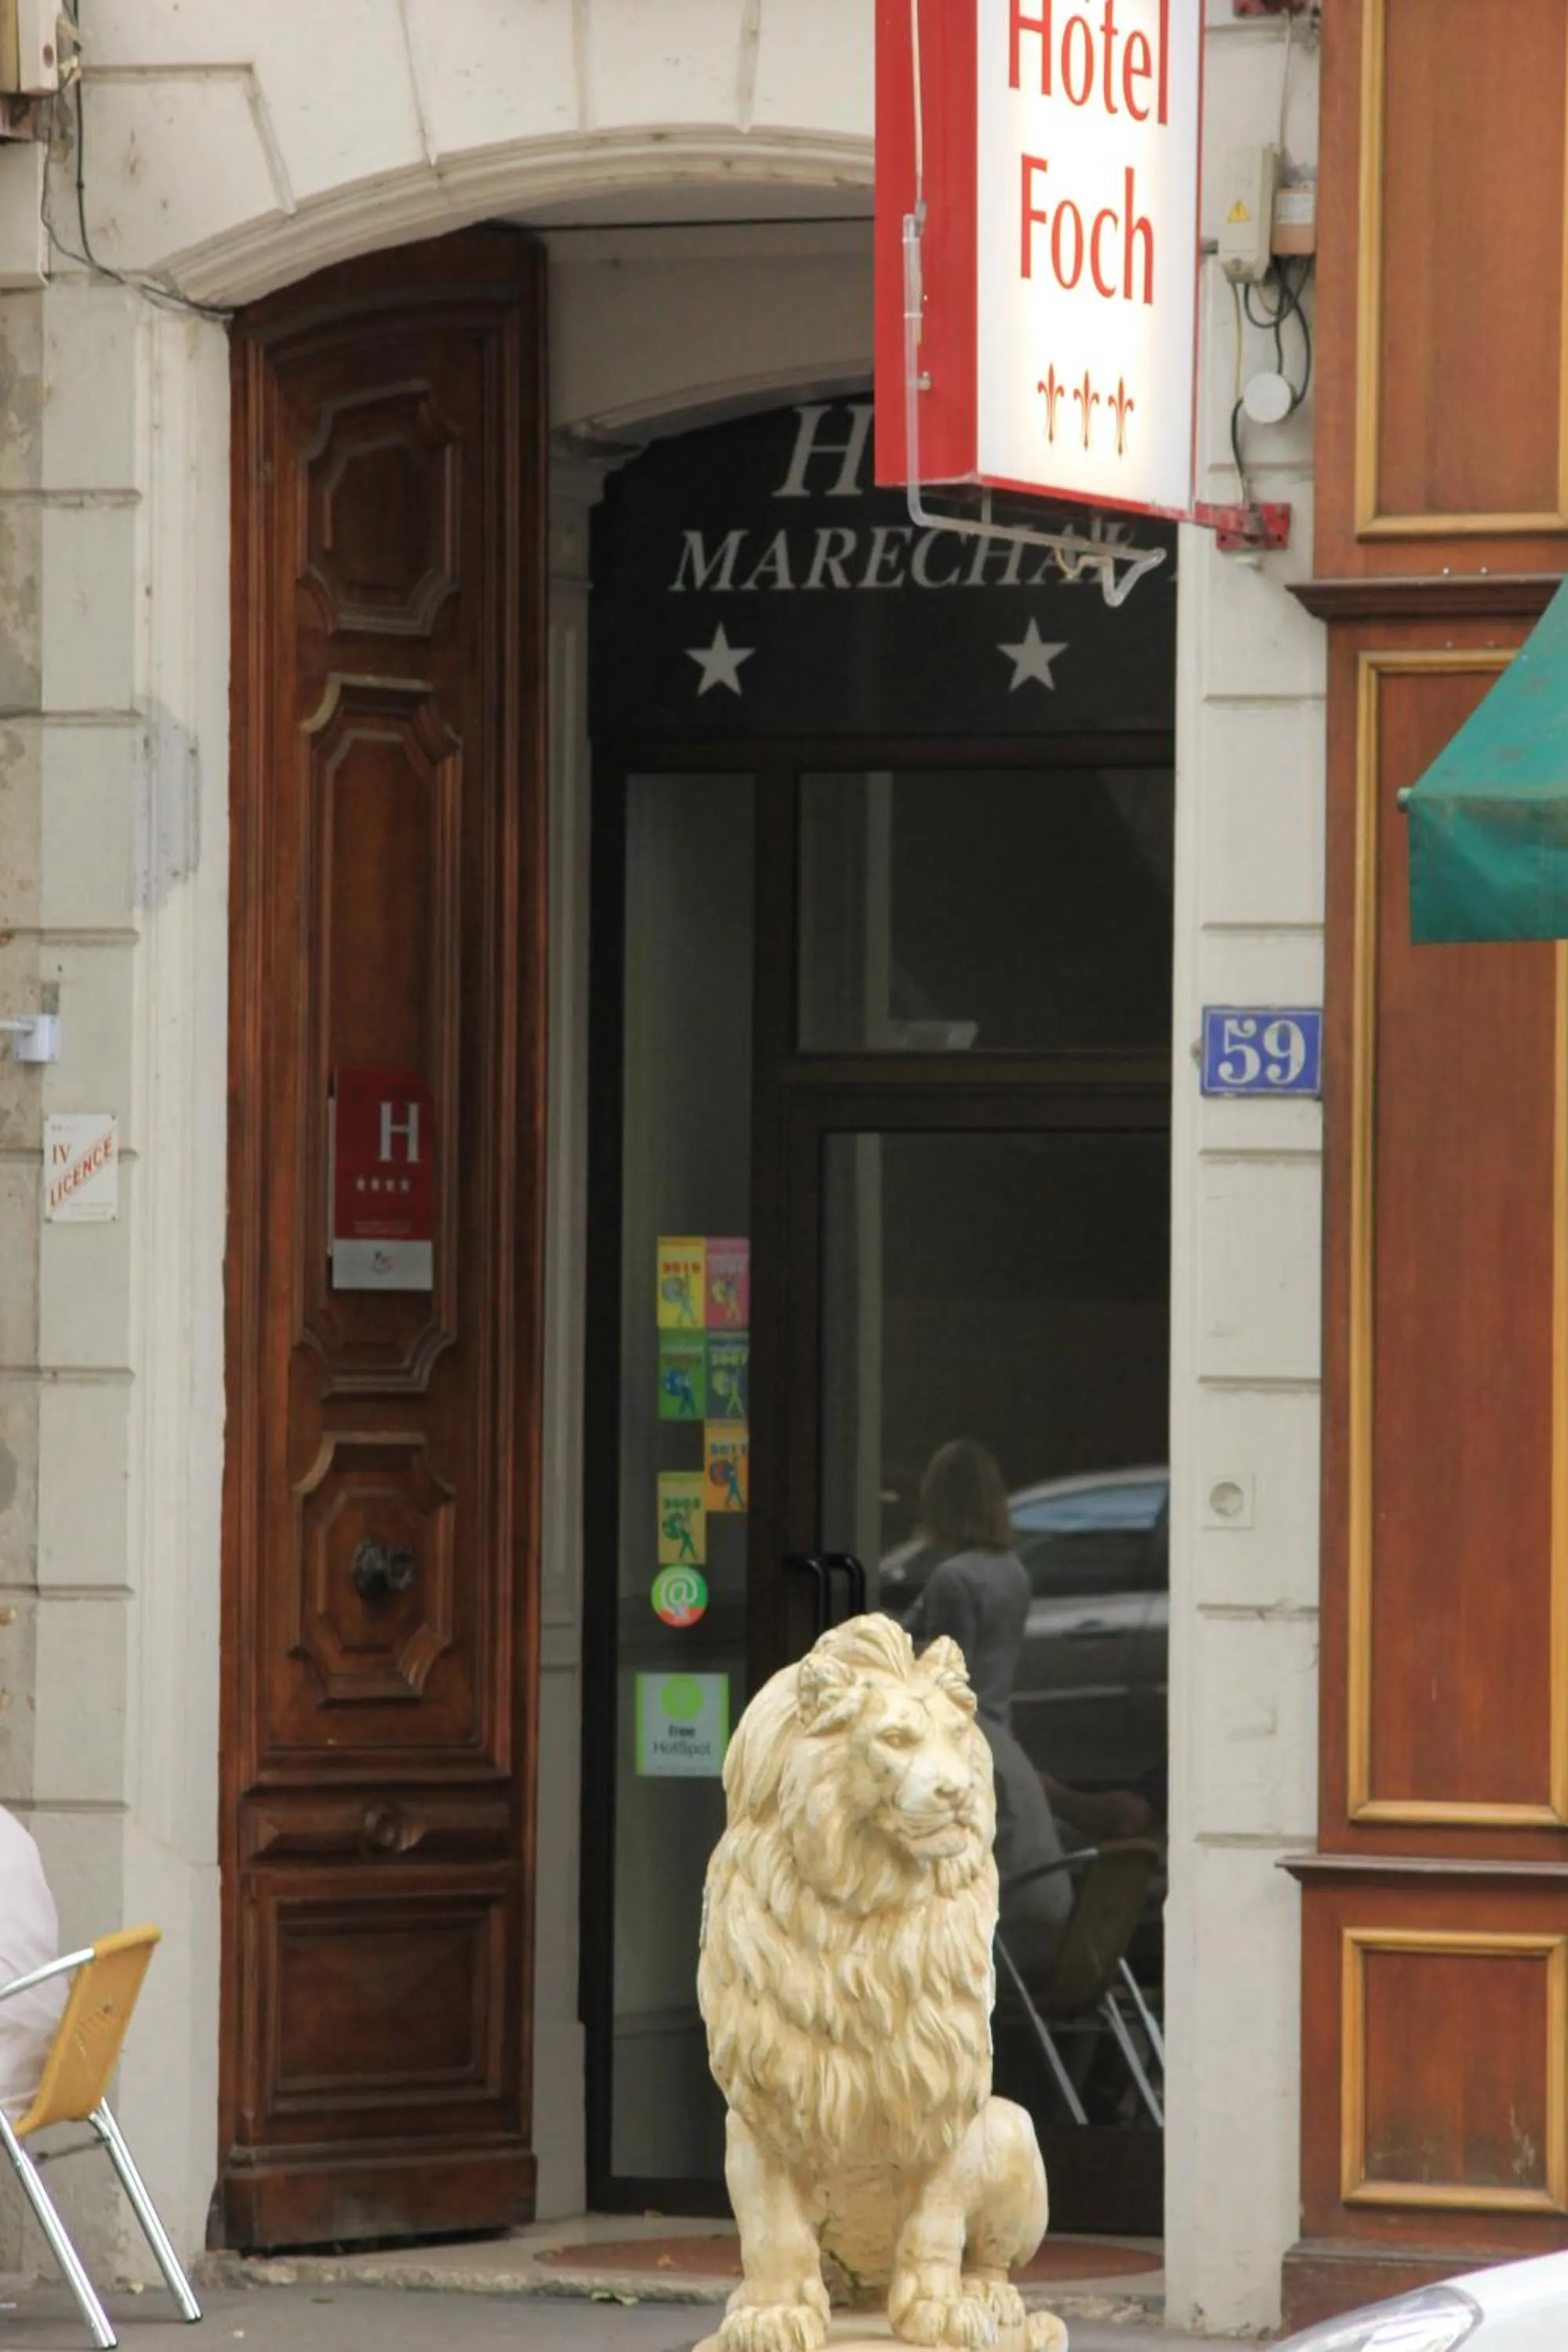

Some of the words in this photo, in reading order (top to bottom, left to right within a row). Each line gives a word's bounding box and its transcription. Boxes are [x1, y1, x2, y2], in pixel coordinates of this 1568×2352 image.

[1020, 151, 1155, 306] Foch
[1218, 1018, 1306, 1084] 59
[53, 1144, 71, 1164] IV
[379, 1102, 420, 1163] H
[50, 1134, 113, 1207] LICENCE
